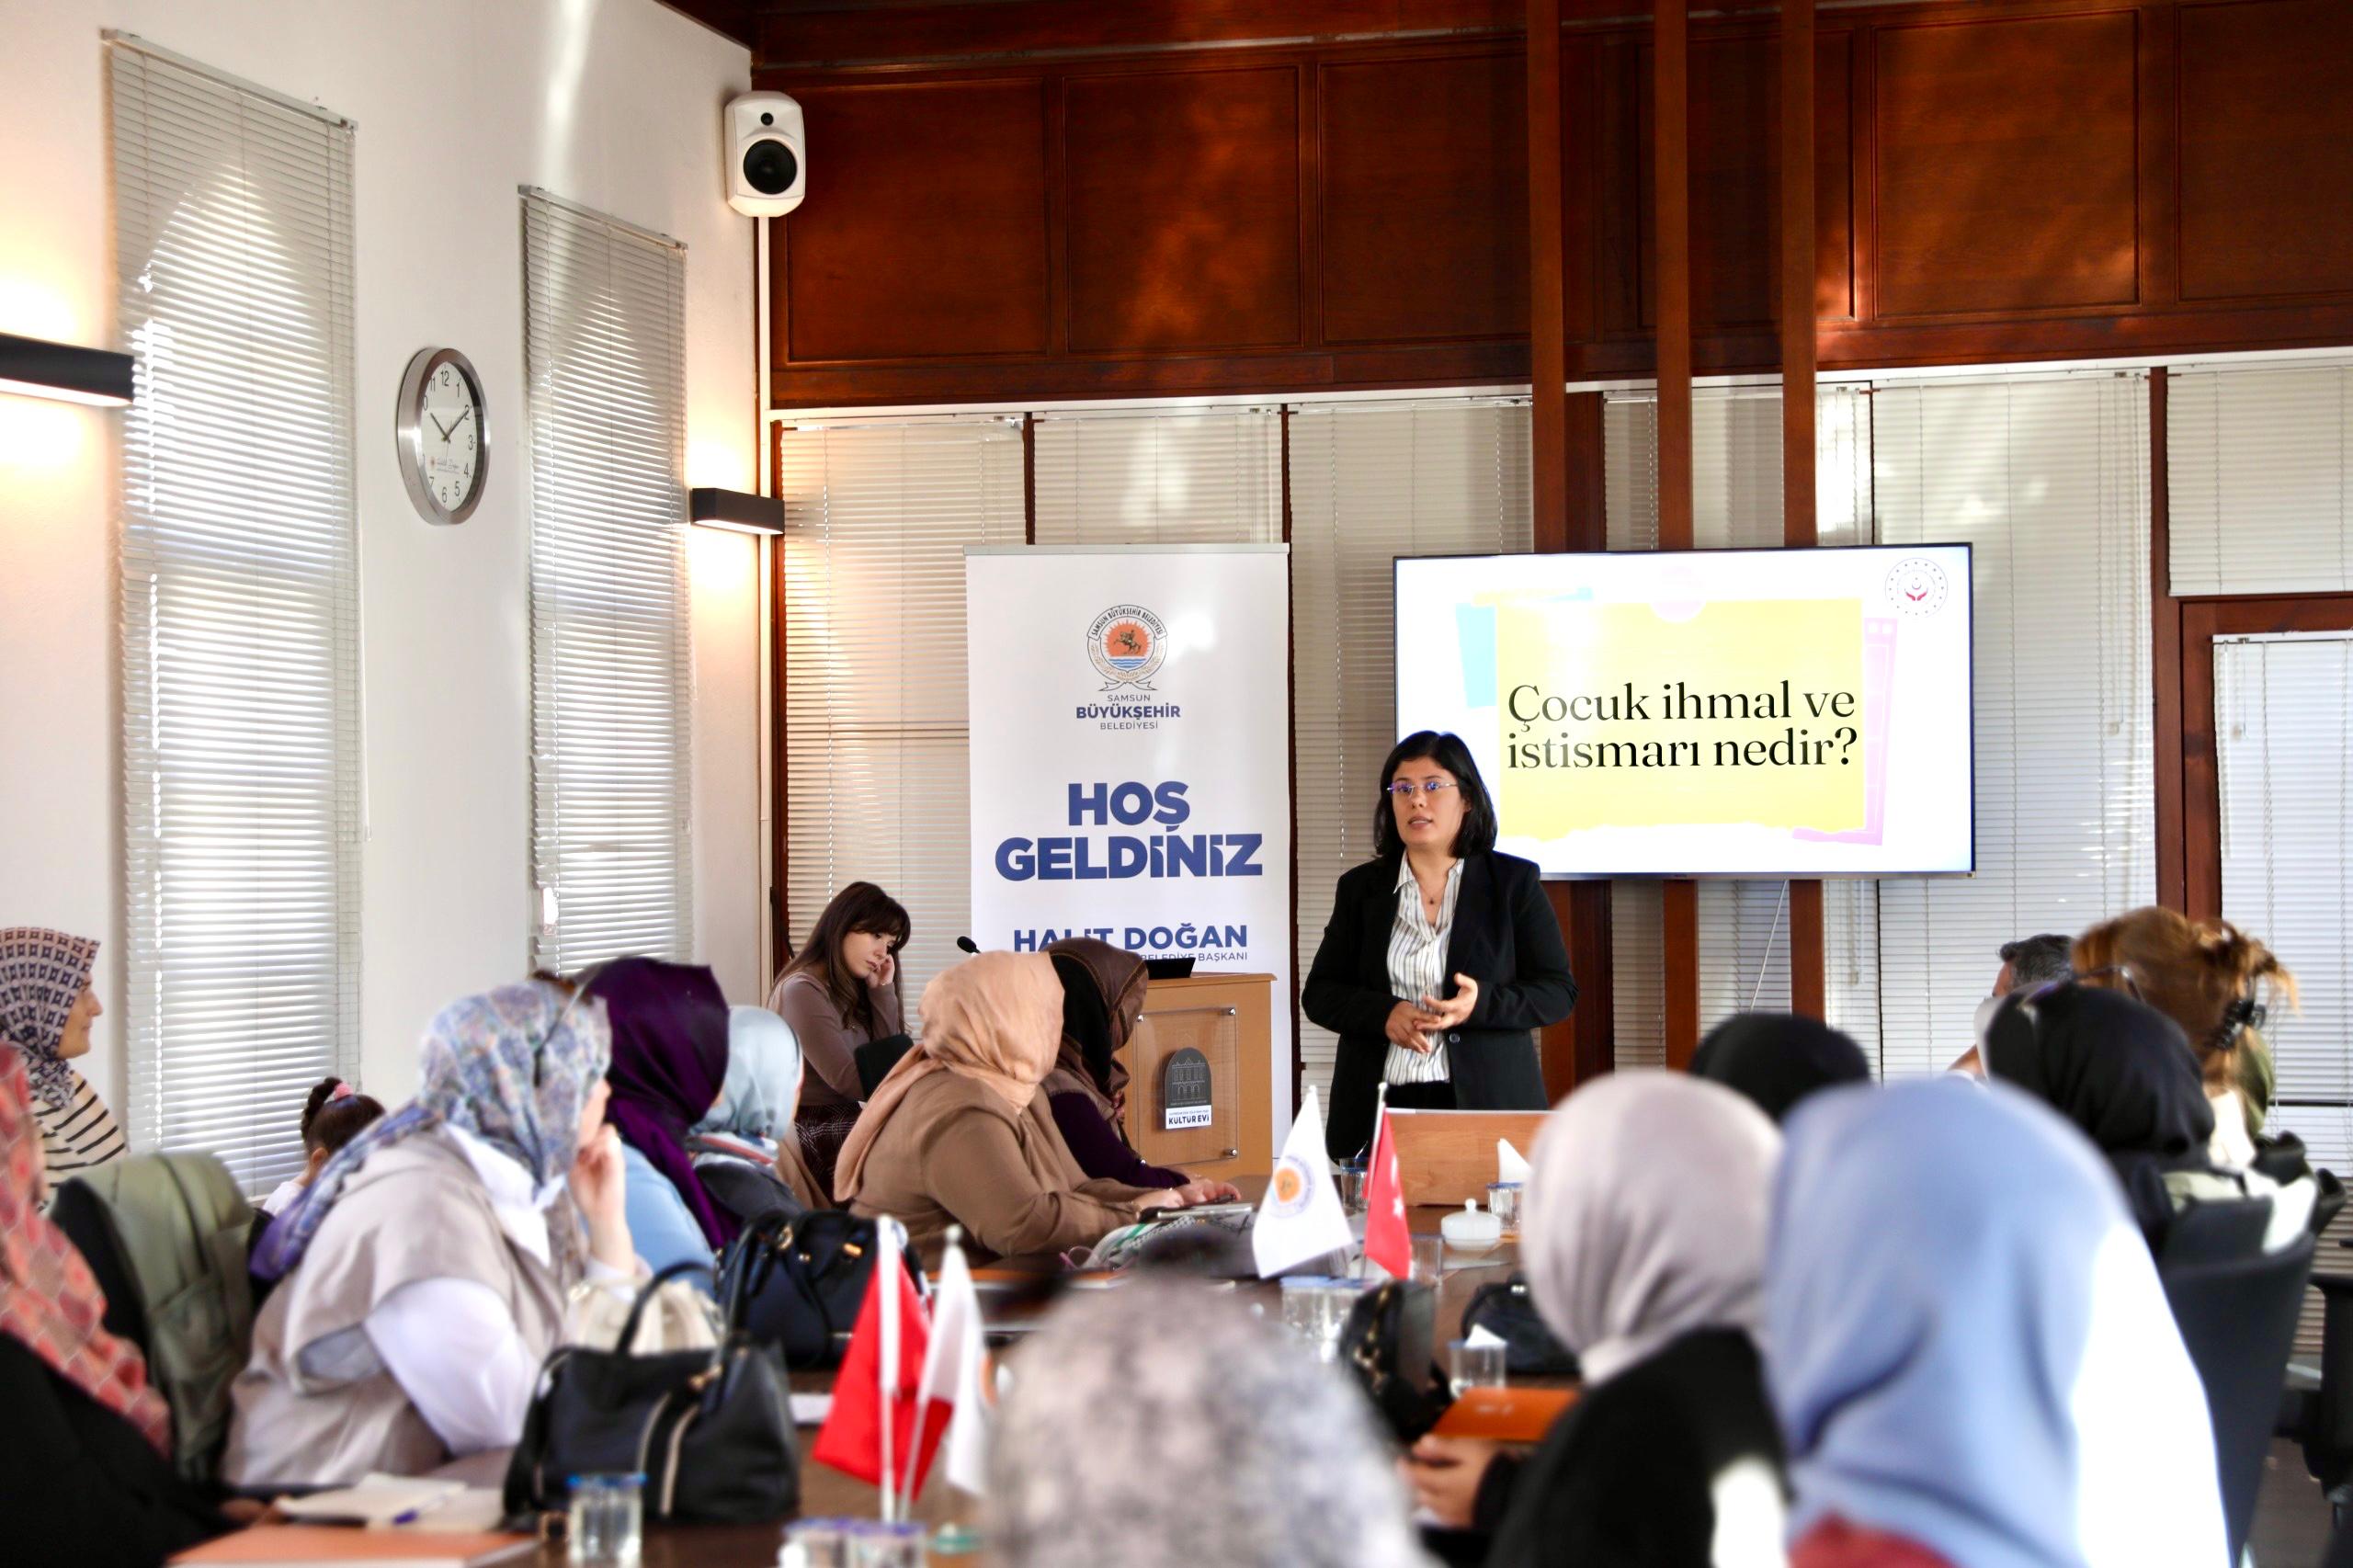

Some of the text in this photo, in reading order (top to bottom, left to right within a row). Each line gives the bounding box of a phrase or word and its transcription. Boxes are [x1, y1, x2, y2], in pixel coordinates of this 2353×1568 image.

[440, 370, 449, 387] 12
[468, 435, 473, 450] 3
[463, 462, 470, 479] 4
[441, 487, 448, 503] 6
[455, 481, 460, 497] 5
[1091, 617, 1108, 636] SAMSUN
[1076, 702, 1181, 720] BÜYÜKŞEHİR
[1507, 680, 1856, 732] Çocuk ihmal ve
[1100, 721, 1158, 730] BELEDİYESİ
[1507, 726, 1858, 769] istismarı nedir?
[1068, 780, 1190, 832] HOŞ
[995, 833, 1263, 881] GELDİNİZ
[1124, 922, 1247, 950] DOĞAN
[1198, 952, 1247, 962] BAŞKANI
